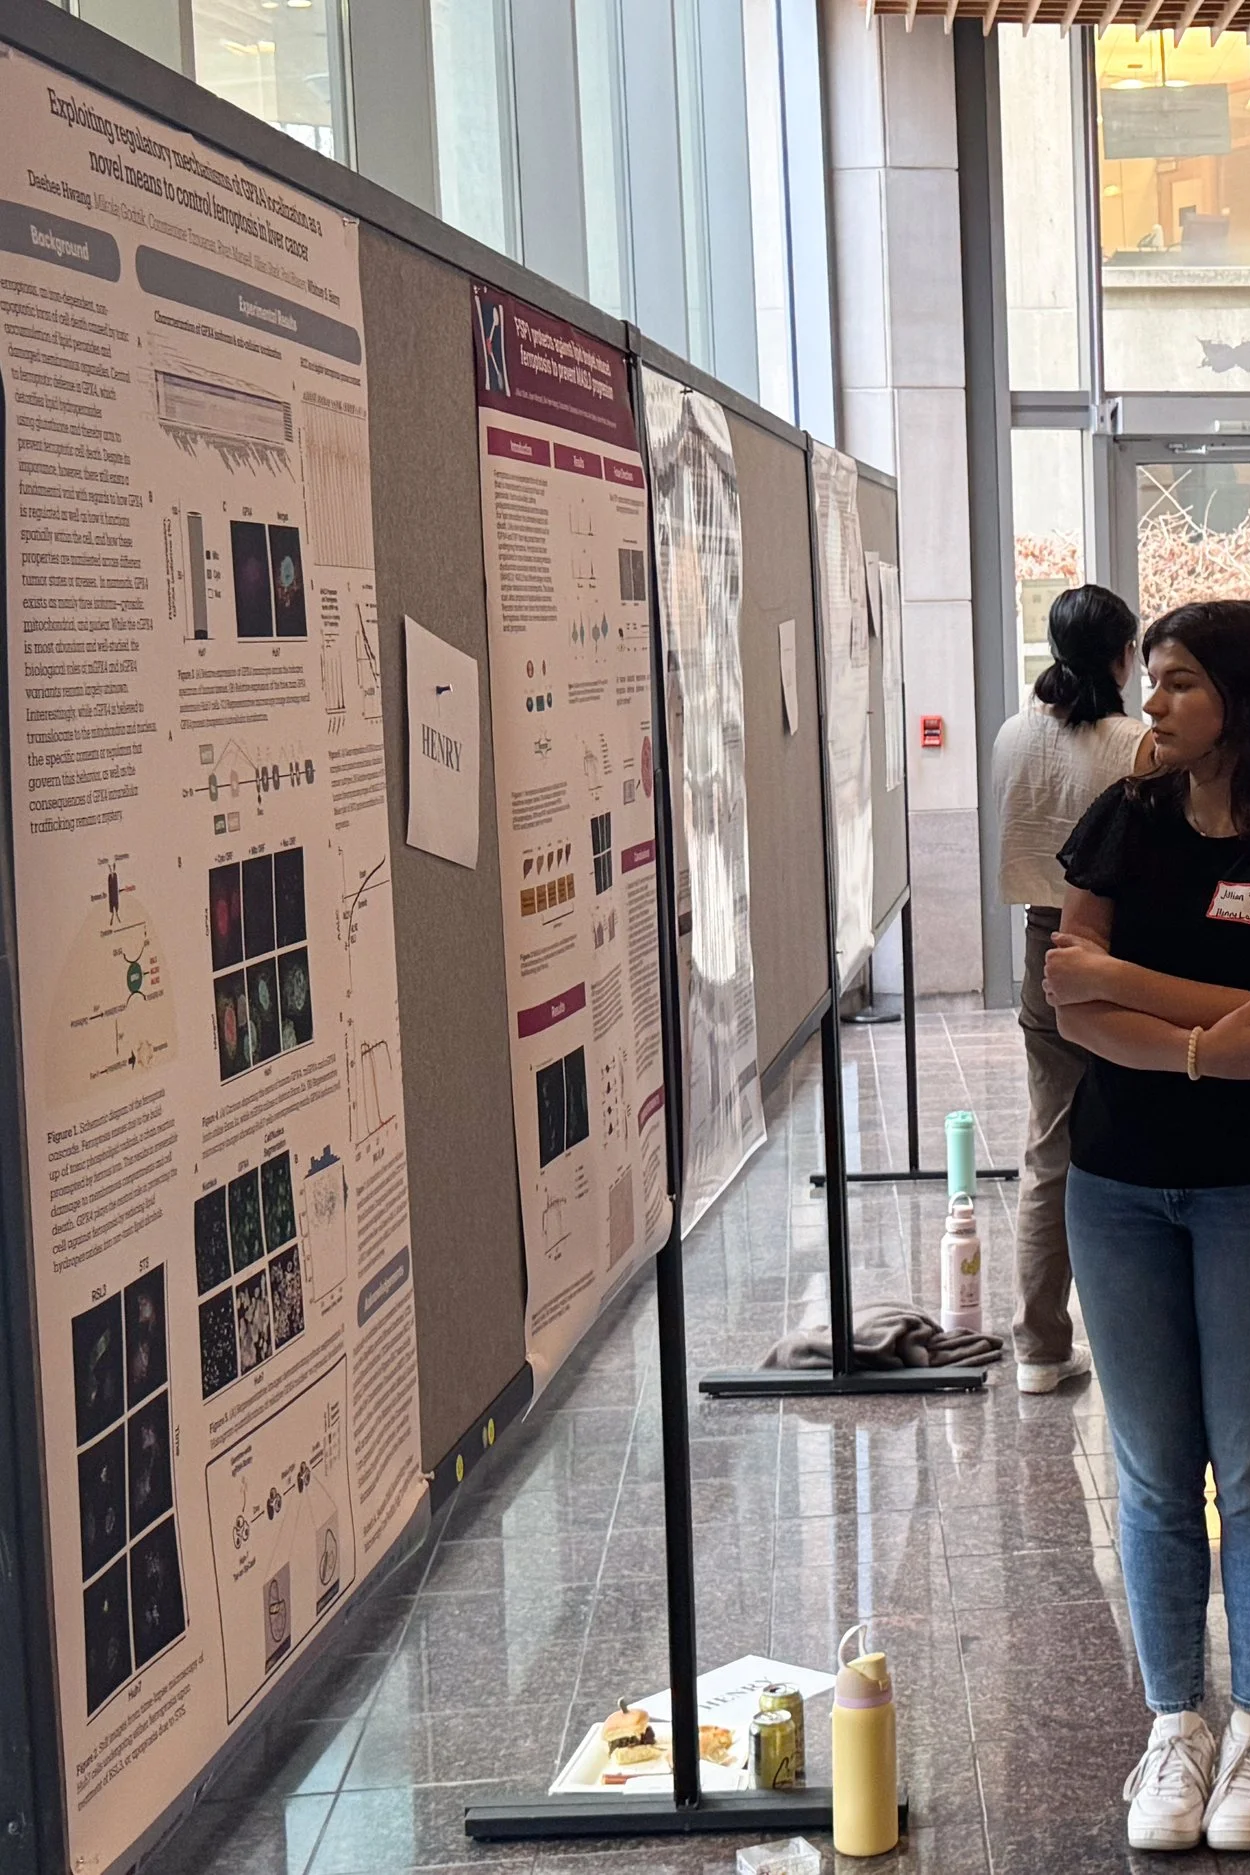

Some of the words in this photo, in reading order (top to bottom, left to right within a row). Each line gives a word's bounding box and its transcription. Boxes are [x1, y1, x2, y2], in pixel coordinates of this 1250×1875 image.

[48, 88, 114, 144] Exploiting
[115, 126, 172, 169] regulatory
[173, 151, 233, 184] mechanisms
[240, 177, 266, 200] GPX4
[30, 224, 90, 262] Background
[90, 151, 122, 182] novel
[124, 167, 161, 197] means
[162, 177, 175, 201] to
[177, 187, 212, 217] control
[213, 198, 258, 237] ferroptosis
[285, 235, 309, 261] cancer
[422, 723, 462, 772] HENRY
